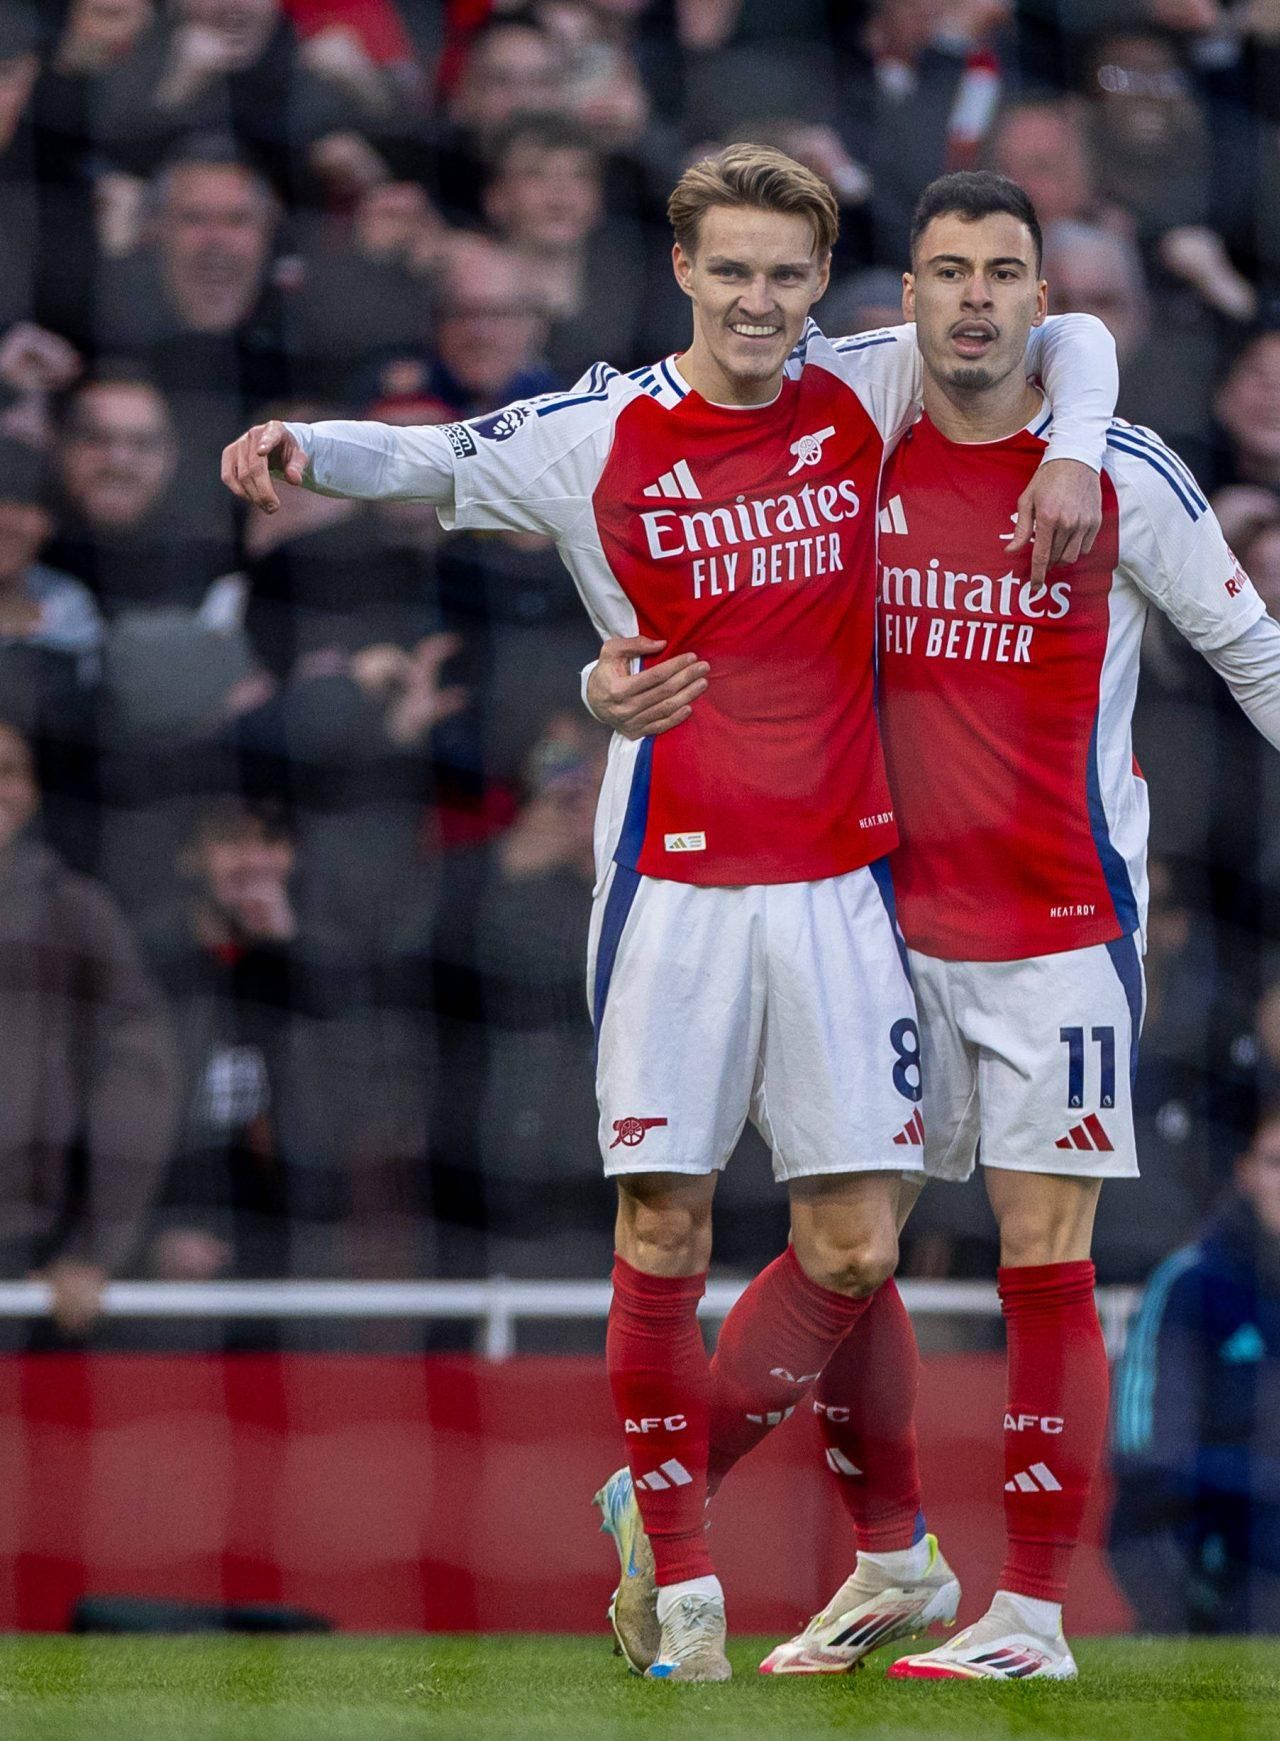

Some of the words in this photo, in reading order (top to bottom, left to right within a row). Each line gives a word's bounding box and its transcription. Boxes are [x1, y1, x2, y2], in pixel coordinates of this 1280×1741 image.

[448, 422, 472, 450] oom
[639, 479, 859, 560] Emirates
[693, 552, 738, 599] FLY
[751, 532, 843, 587] BETTER
[878, 558, 1071, 619] mirates
[885, 613, 918, 655] FLY
[925, 618, 1034, 663] BETTER
[859, 811, 893, 829] HEAT.RDY
[1050, 904, 1095, 918] HEAT.RDY
[890, 1017, 922, 1101] 8
[1059, 1026, 1115, 1108] 11
[625, 1414, 688, 1434] AFC
[812, 1401, 850, 1423] FC
[1003, 1413, 1064, 1434] AFC
